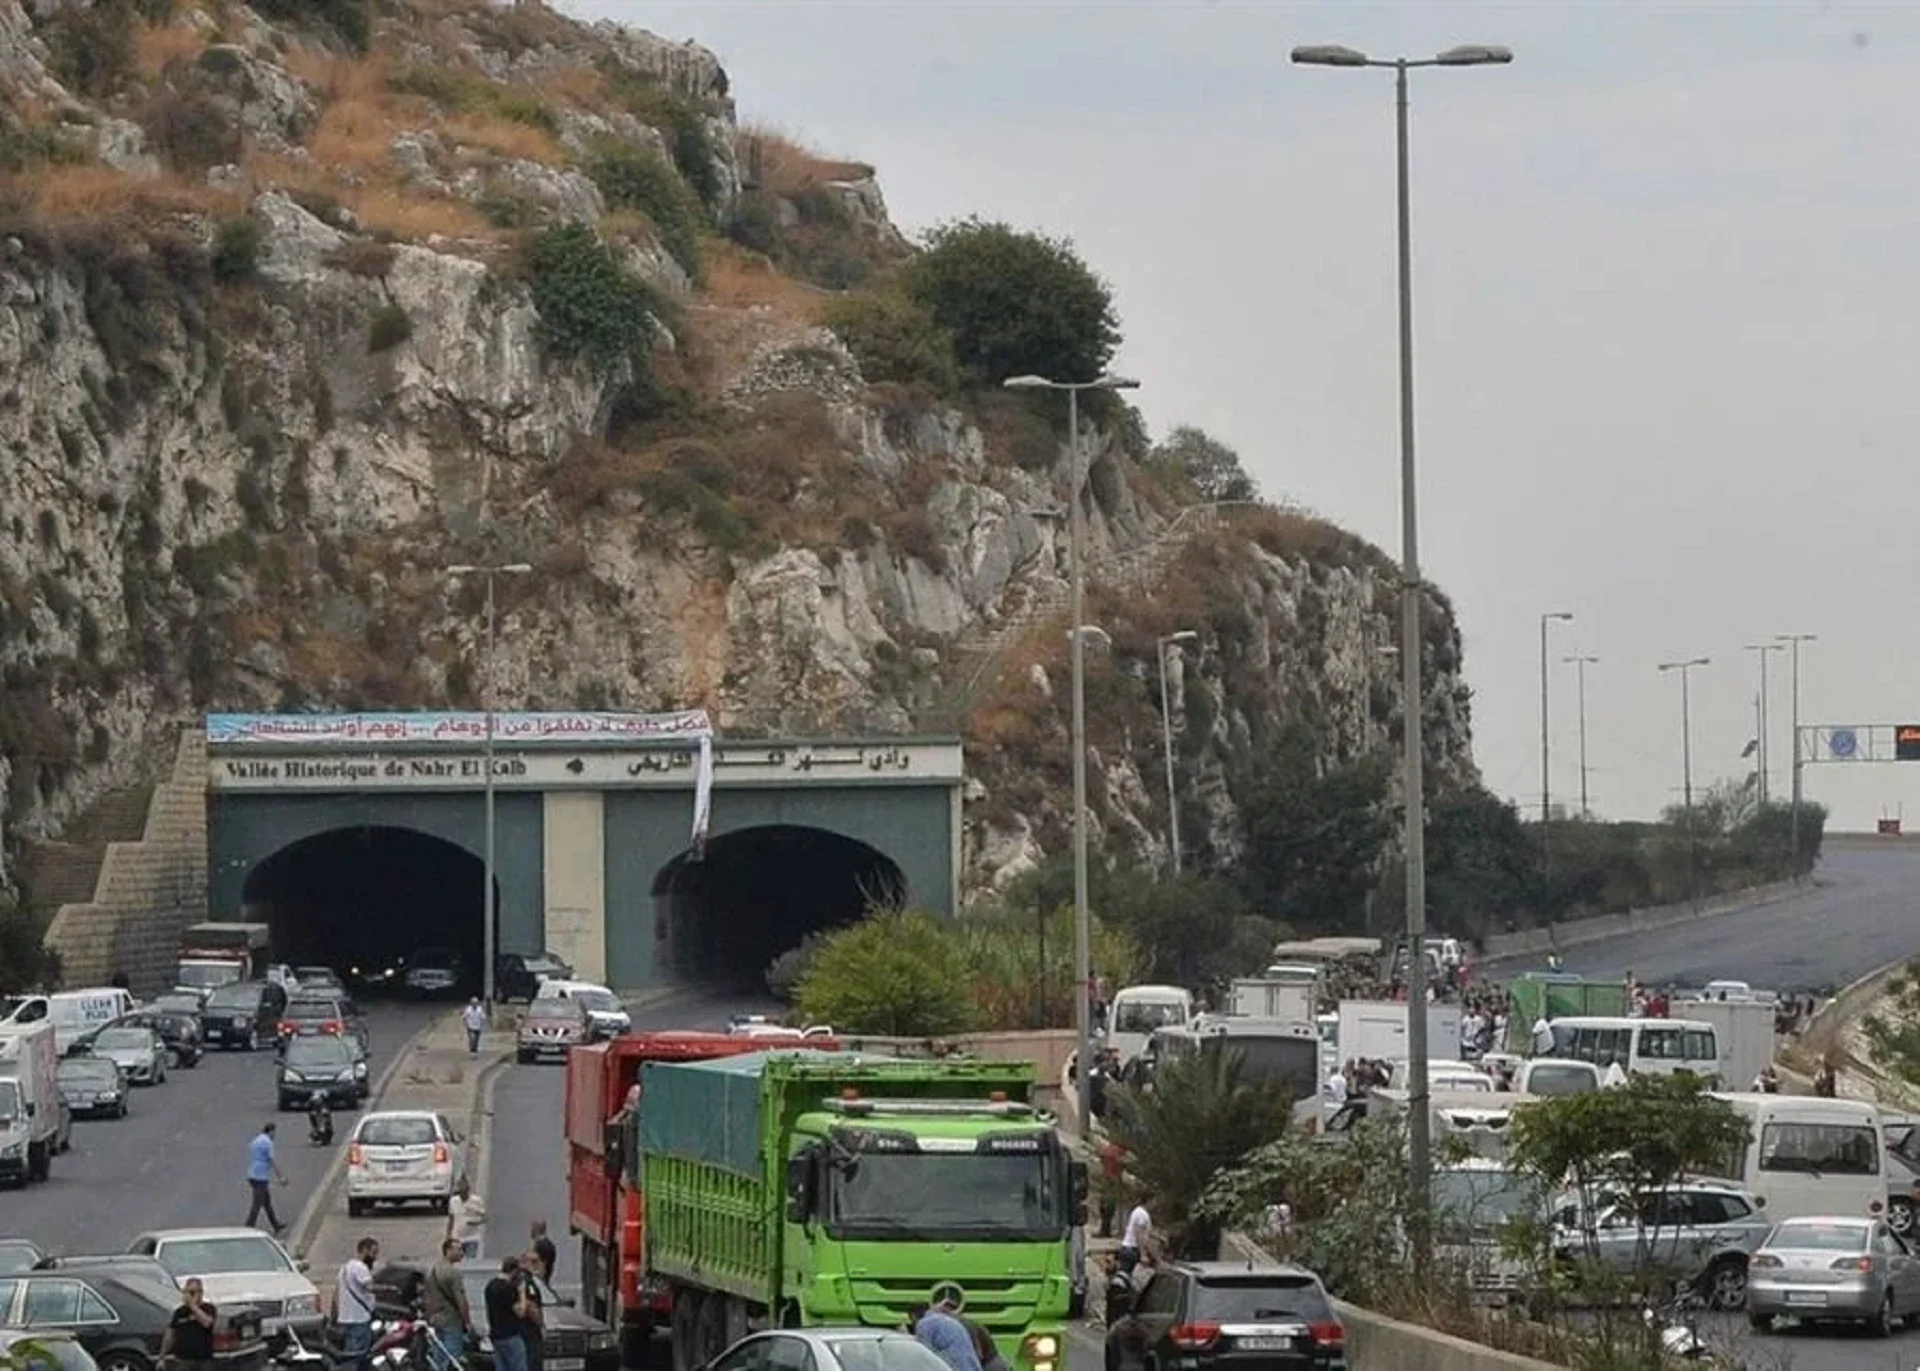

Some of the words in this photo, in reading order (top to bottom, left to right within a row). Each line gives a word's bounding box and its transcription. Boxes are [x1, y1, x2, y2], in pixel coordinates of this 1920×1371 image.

[285, 761, 376, 781] Historique
[384, 760, 405, 776] de
[411, 760, 456, 777] Nahr
[461, 760, 479, 776] El
[868, 749, 910, 771] وادي
